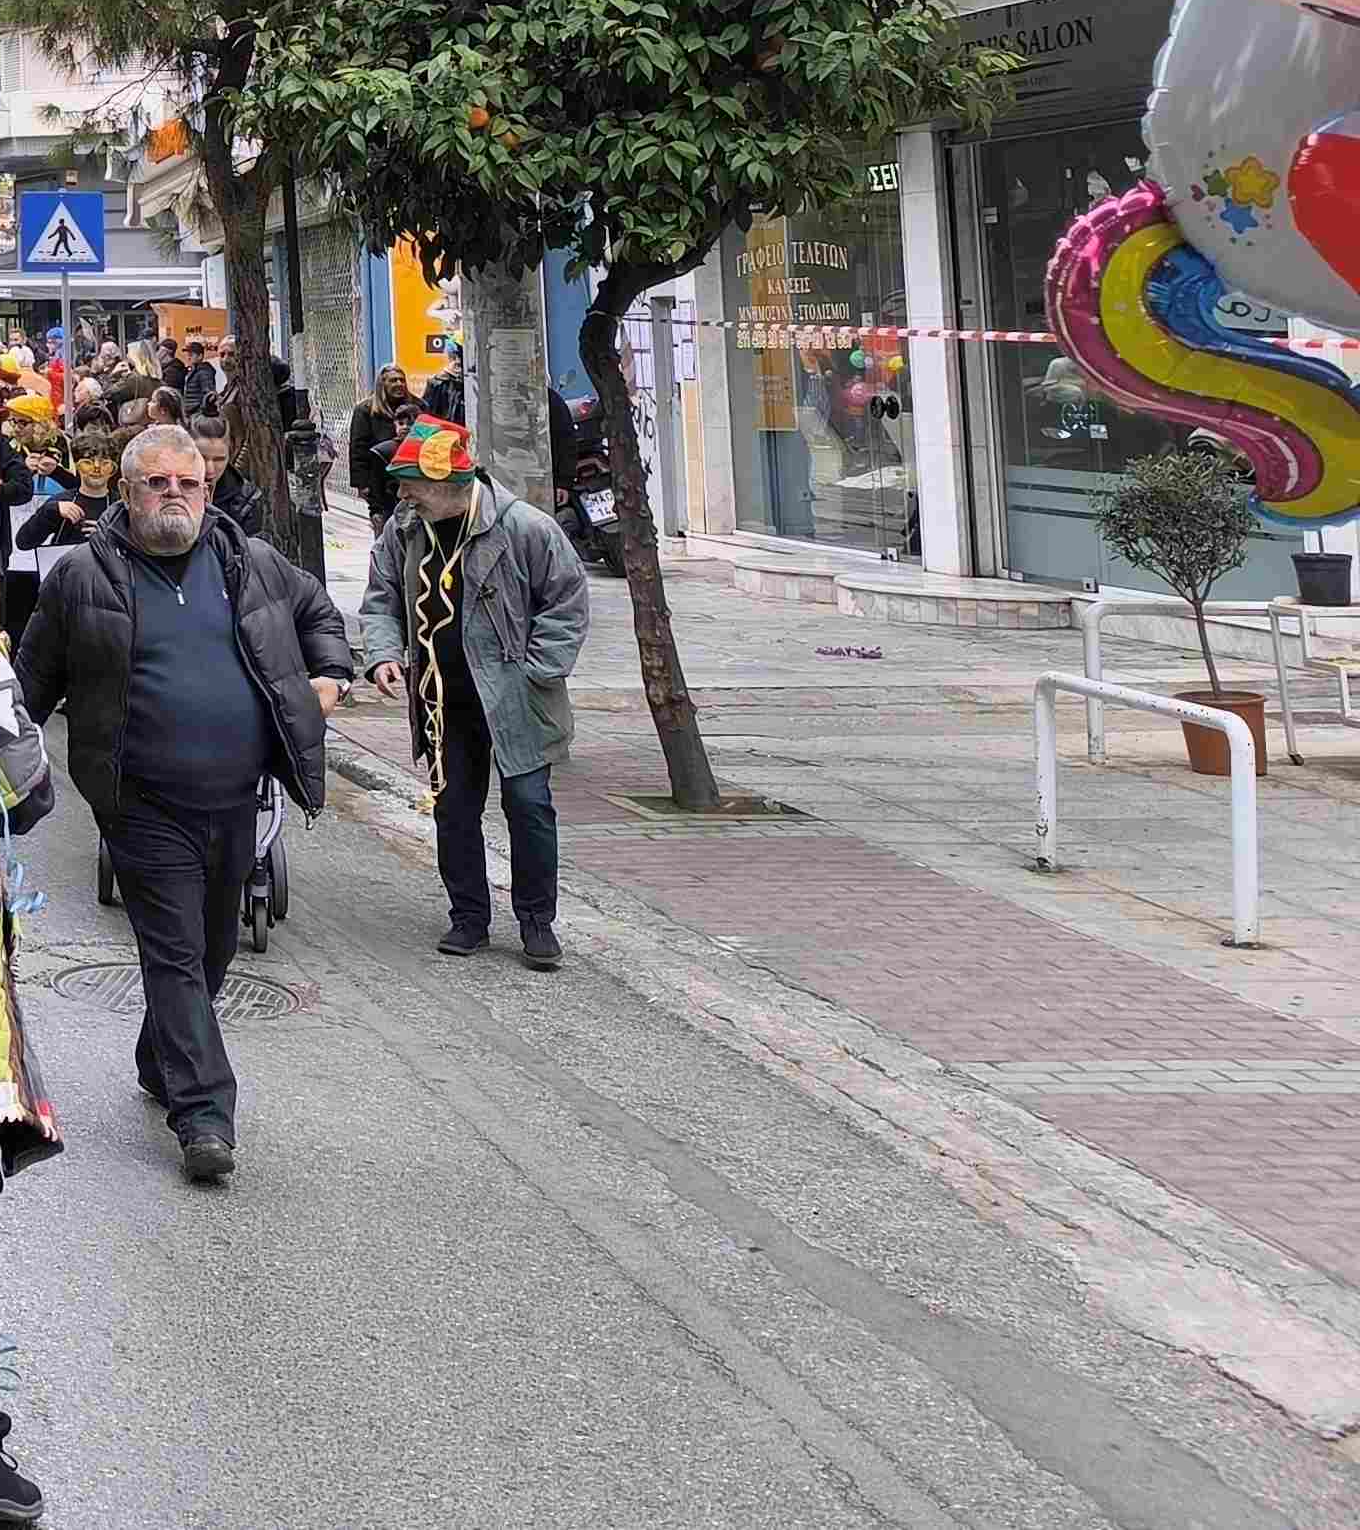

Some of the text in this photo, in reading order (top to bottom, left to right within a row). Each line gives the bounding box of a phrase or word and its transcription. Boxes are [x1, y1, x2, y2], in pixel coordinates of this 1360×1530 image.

[1015, 16, 1095, 57] SALON
[736, 241, 848, 278] ΓΡΑΦΕΙΟ ΤΕΛΕΤΩΝ
